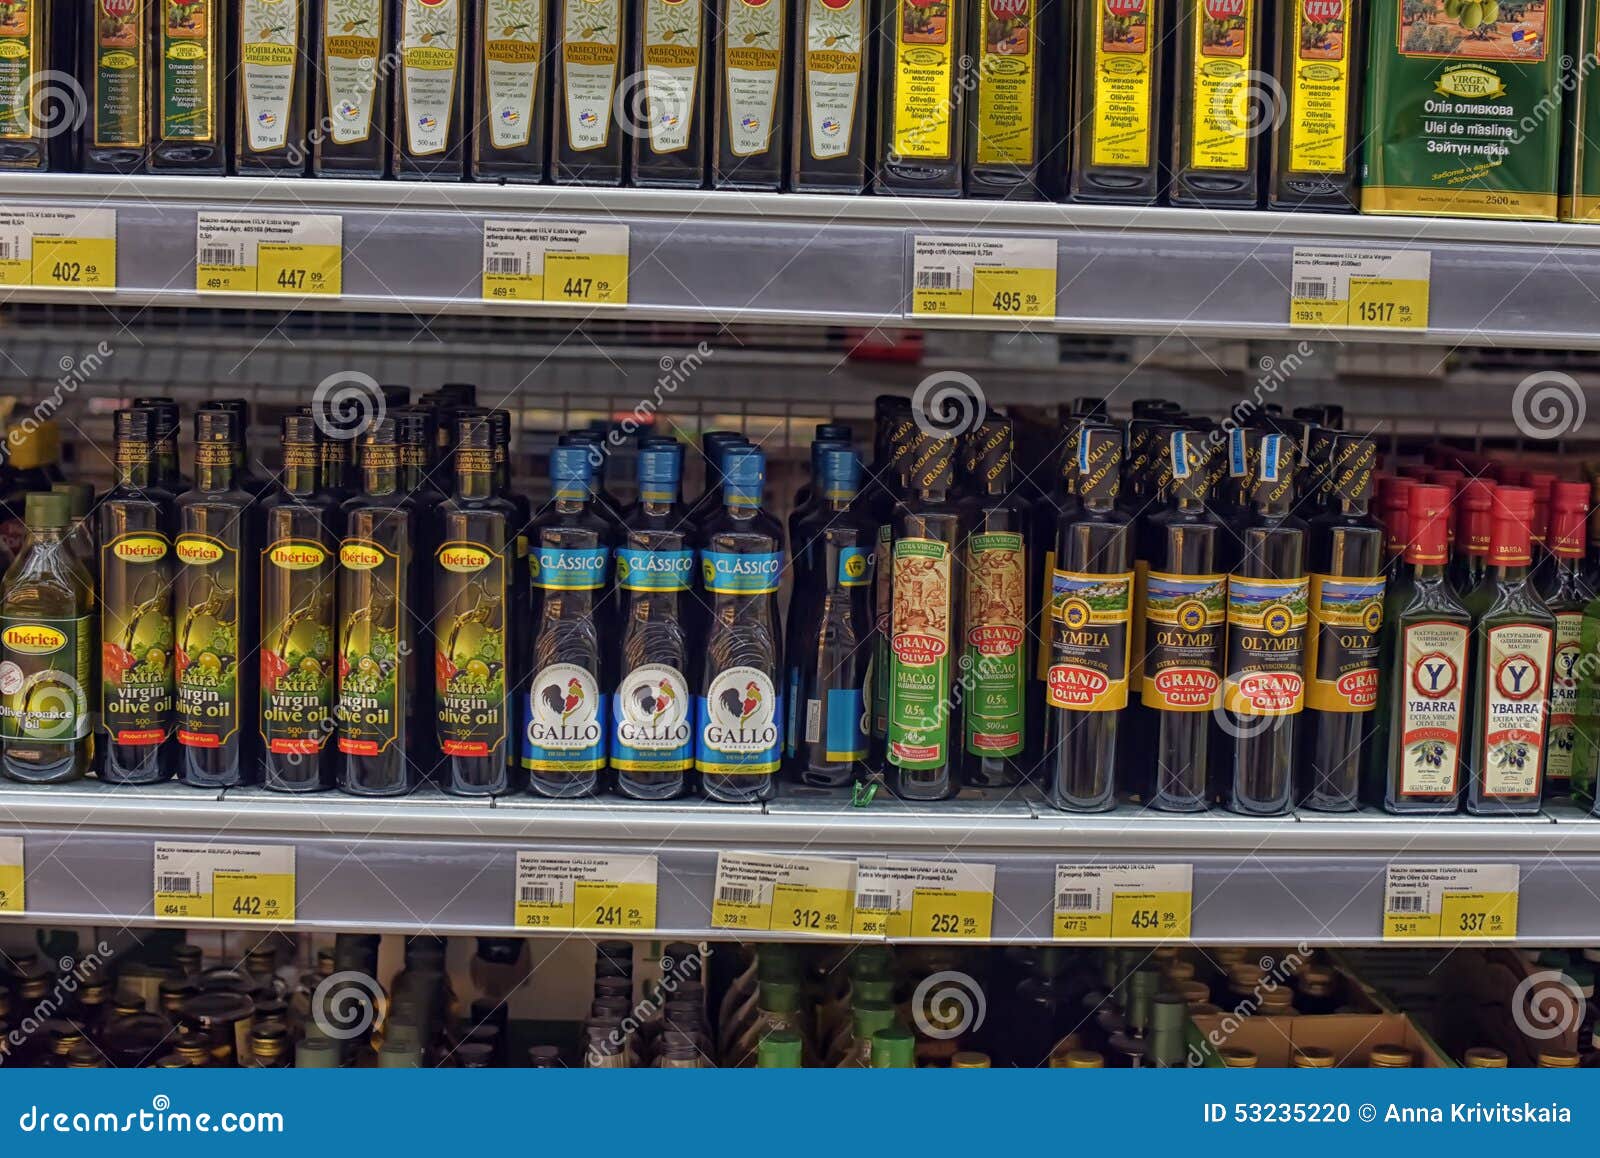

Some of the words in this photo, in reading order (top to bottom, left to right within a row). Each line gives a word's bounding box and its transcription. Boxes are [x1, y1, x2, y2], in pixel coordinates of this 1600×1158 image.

[329, 39, 376, 49] ARBEQUINA
[488, 43, 536, 53] ARBEQUINA
[567, 46, 614, 55] ARBEQUINA
[648, 48, 695, 57] ARBEQUINA
[729, 51, 775, 60] ARBEQUINA
[810, 54, 856, 63] ARBEQUINA
[1452, 75, 1490, 85] VIRGEN
[1454, 84, 1487, 93] EXTRA
[1425, 100, 1452, 113] Олія
[1455, 104, 1513, 115] оливкова
[1425, 121, 1446, 133] Ulei
[1450, 123, 1464, 134] de
[1486, 196, 1508, 205] 2500
[53, 262, 80, 282] 402
[85, 265, 96, 273] 49
[277, 269, 306, 289] 447
[564, 278, 592, 298] 447
[923, 302, 937, 310] 520
[993, 292, 1021, 311] 495
[1360, 302, 1394, 321] 1517
[1080, 467, 1106, 495] GRAND
[120, 544, 164, 556] Ibérica
[179, 545, 218, 559] Ibérica
[275, 551, 320, 563] Ibérica
[342, 551, 378, 564] Ibérica
[443, 554, 485, 566] Ibérica
[540, 554, 604, 569] CLÁSSICO
[630, 556, 692, 572] CLÁSSICO
[716, 558, 779, 574] CLÁSSICO
[8, 631, 59, 646] Ibérica
[973, 629, 1020, 641] GRAND
[894, 637, 942, 652] GRAND
[902, 654, 932, 662] OLIVA
[122, 670, 162, 683] Extra
[181, 671, 217, 686] Extra
[1050, 669, 1103, 690] GRAND
[1160, 673, 1217, 689] GRAND
[1424, 664, 1446, 690] Y
[1508, 665, 1530, 692] Y
[275, 677, 317, 691] Extra
[341, 678, 375, 693] Extra
[446, 680, 485, 694] Extra
[1245, 678, 1300, 692] GRAND
[118, 686, 164, 702] virgin
[179, 688, 219, 705] virgin
[1056, 689, 1089, 700] OLIVA
[1170, 693, 1205, 702] OLIVA
[1256, 696, 1291, 706] OLIVA
[109, 700, 150, 713] olive
[154, 698, 172, 712] oil
[206, 703, 229, 717] oil
[271, 694, 319, 713] virgin
[443, 696, 487, 714] virgin
[1408, 701, 1456, 712] YBARRA
[1491, 703, 1539, 714] YBARRA
[264, 708, 302, 721] olive
[307, 707, 328, 721] oil
[365, 709, 389, 724] oil
[439, 709, 471, 724] olive
[476, 709, 498, 724] oil
[26, 718, 40, 729] oil
[530, 723, 598, 741] GALLO
[621, 724, 689, 741] GALLO
[708, 726, 775, 744] GALLO
[164, 905, 178, 913] 464
[233, 896, 261, 915] 442
[527, 915, 540, 924] 253
[596, 906, 622, 925] 241
[628, 910, 639, 918] 29
[793, 908, 820, 928] 312
[825, 914, 836, 922] 49
[1131, 911, 1158, 928] 454
[1460, 913, 1486, 931] 337
[863, 922, 876, 931] 265
[931, 914, 959, 933] 252
[1064, 921, 1078, 929] 477
